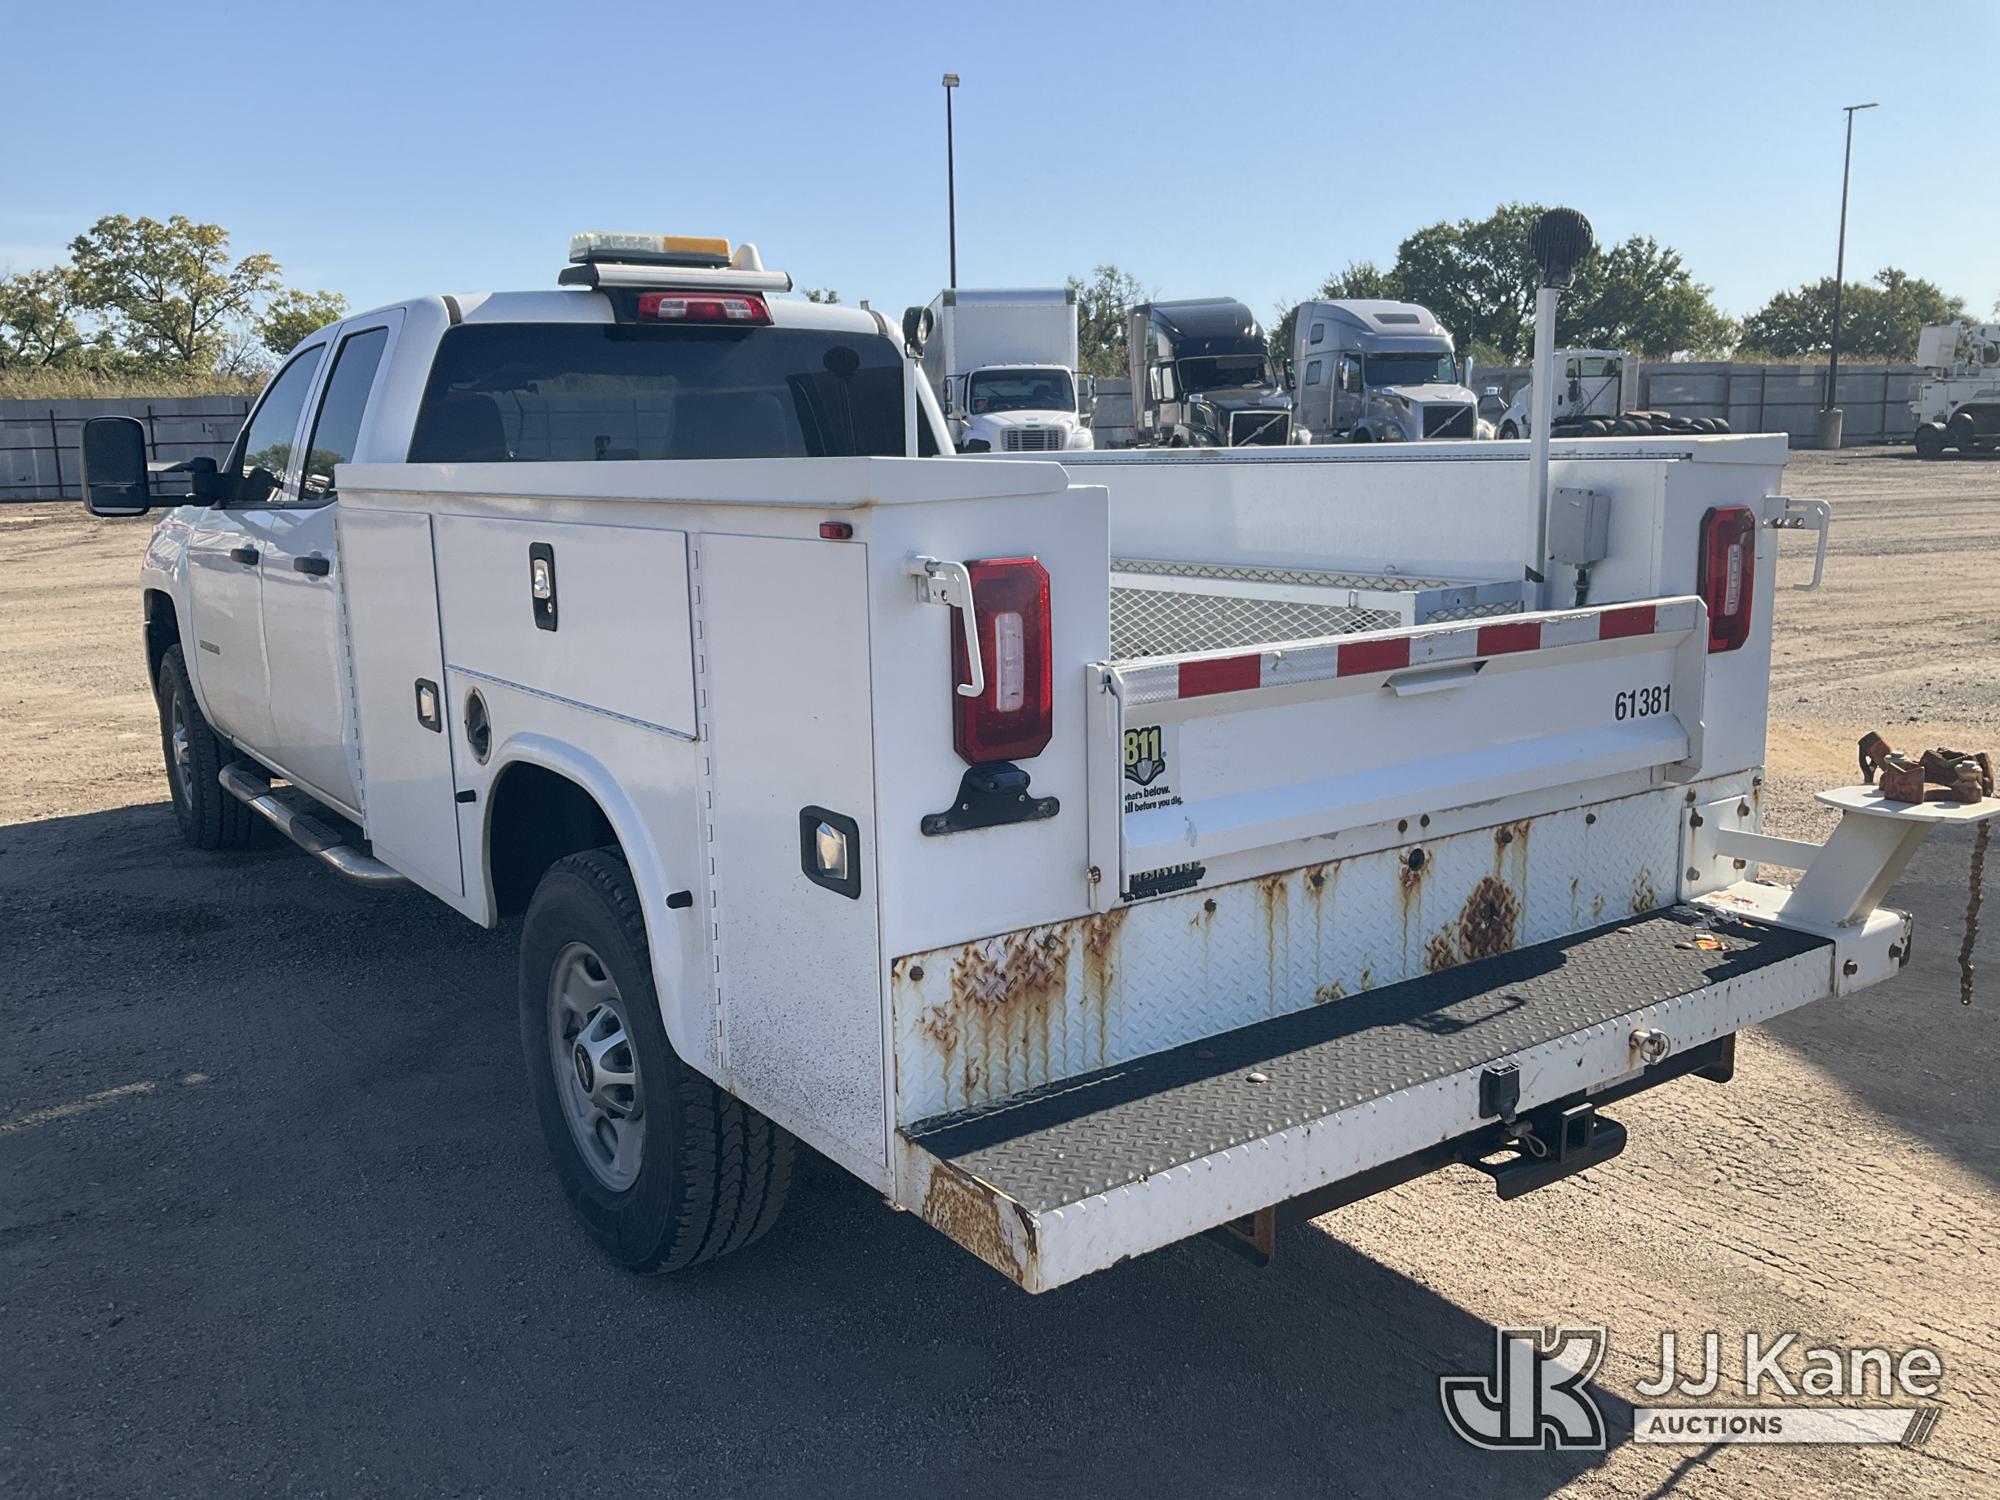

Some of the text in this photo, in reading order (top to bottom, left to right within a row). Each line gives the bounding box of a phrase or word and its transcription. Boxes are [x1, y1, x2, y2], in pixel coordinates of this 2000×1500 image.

[1615, 684, 1671, 721] 61381
[1124, 726, 1161, 766] 811
[1134, 801, 1157, 812] before
[1157, 799, 1171, 809] you
[1170, 795, 1184, 806] dig.
[1143, 785, 1171, 798] below.
